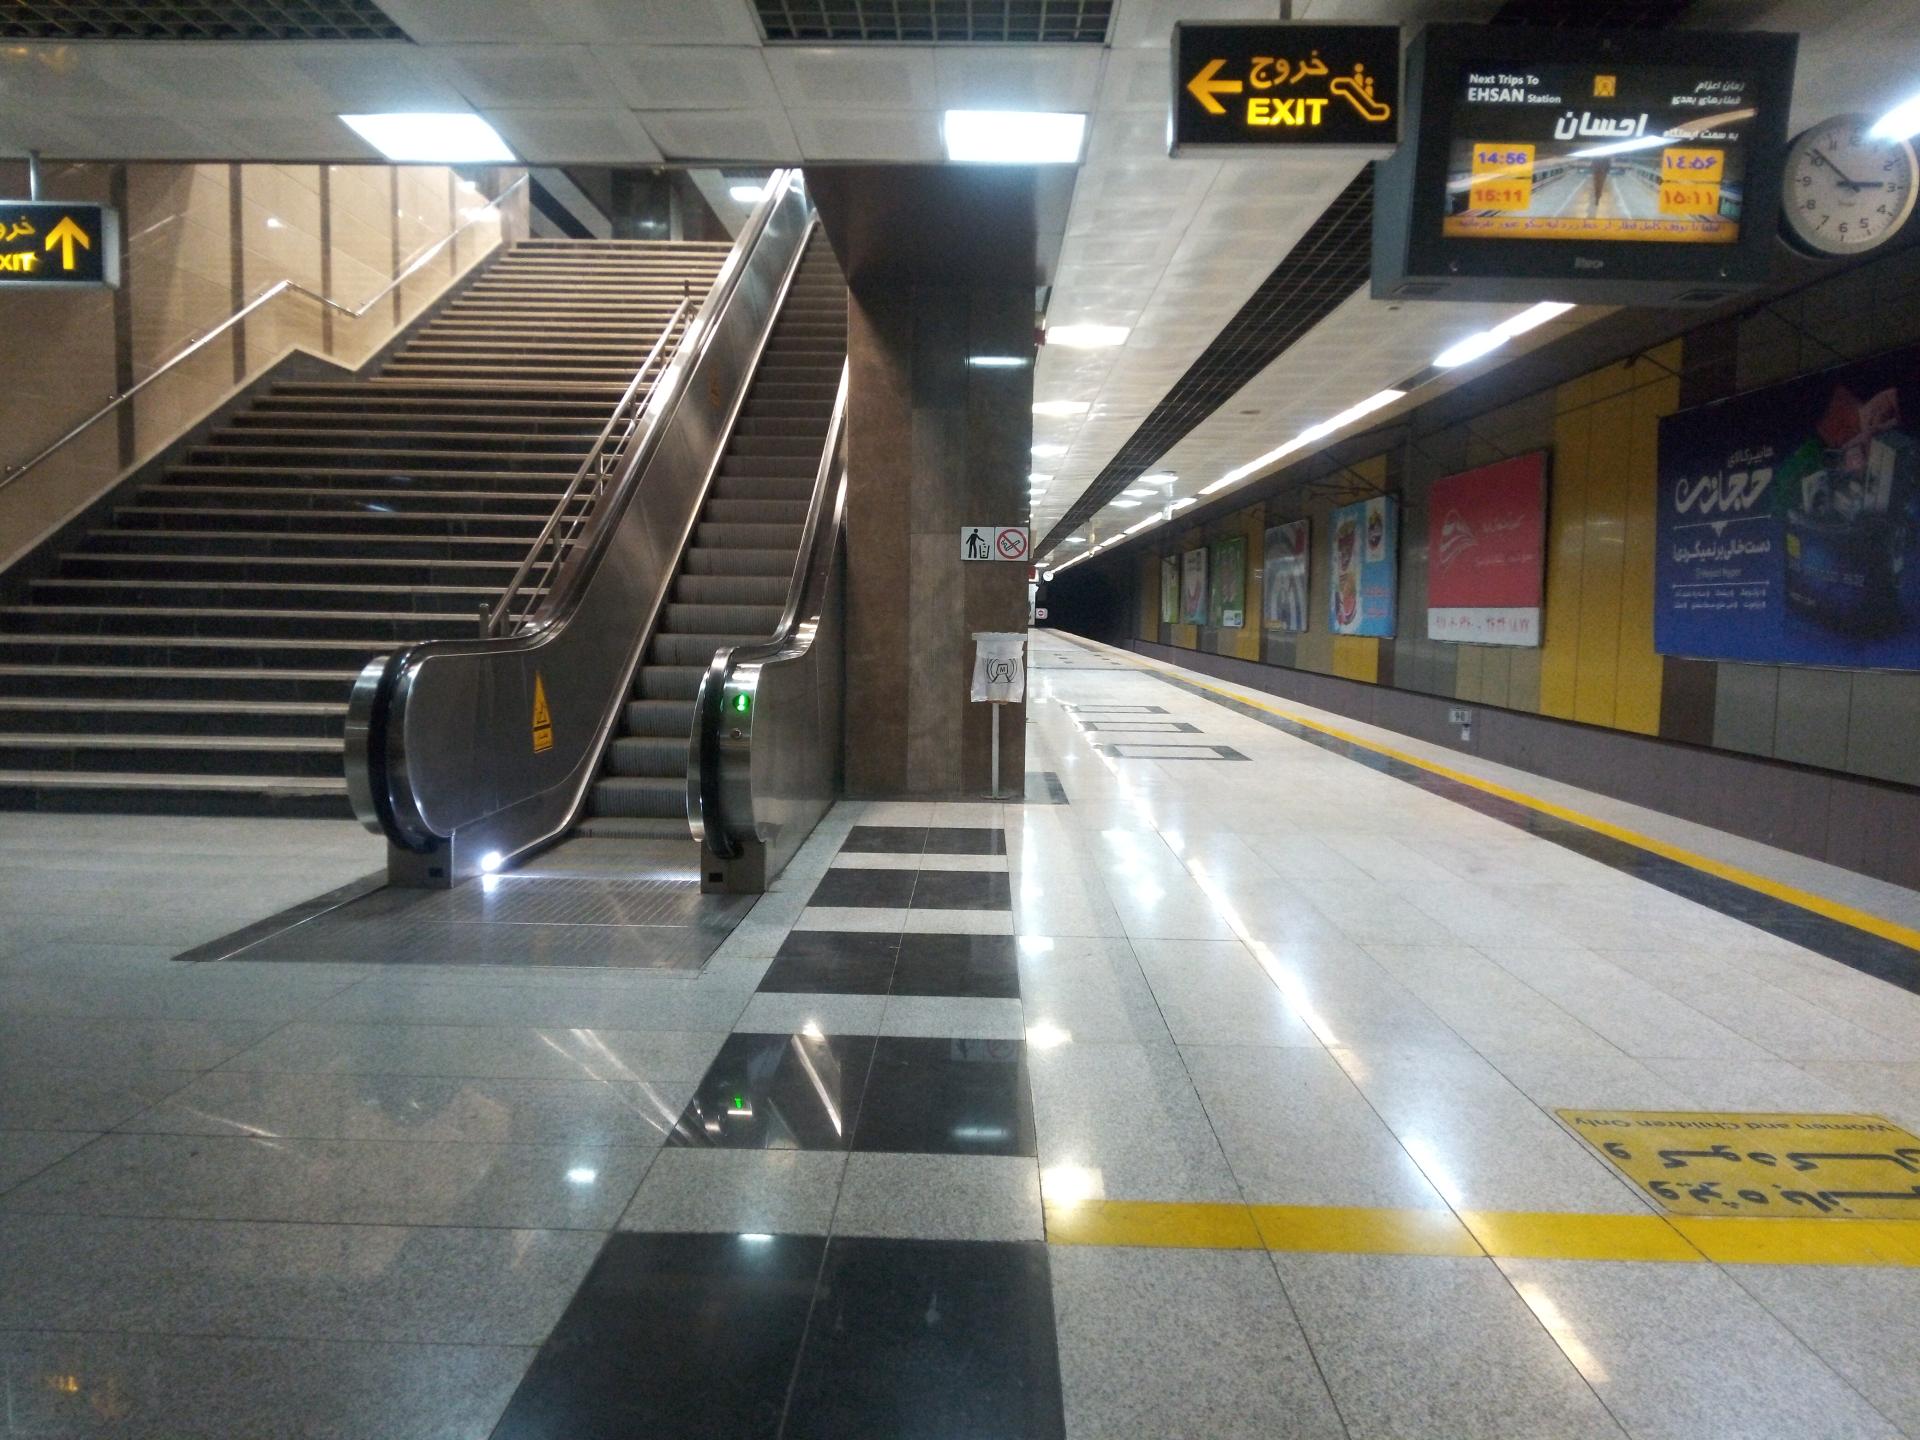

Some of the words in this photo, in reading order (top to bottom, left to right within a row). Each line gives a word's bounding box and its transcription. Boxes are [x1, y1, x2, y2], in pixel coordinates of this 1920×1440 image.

[1250, 50, 1329, 89] خروج
[1469, 73, 1496, 84] Next
[1498, 74, 1524, 87] Trips
[1527, 75, 1540, 85] To
[1467, 87, 1525, 102] EHSAN
[1527, 93, 1562, 104] Station
[1247, 98, 1329, 125] EXIT
[1554, 111, 1649, 140] احسان
[1478, 151, 1527, 165] 14:56
[0, 252, 37, 272] XIT
[1575, 1117, 1631, 1128] Only
[1744, 1122, 1790, 1130] and
[1795, 1122, 1896, 1133] Women
